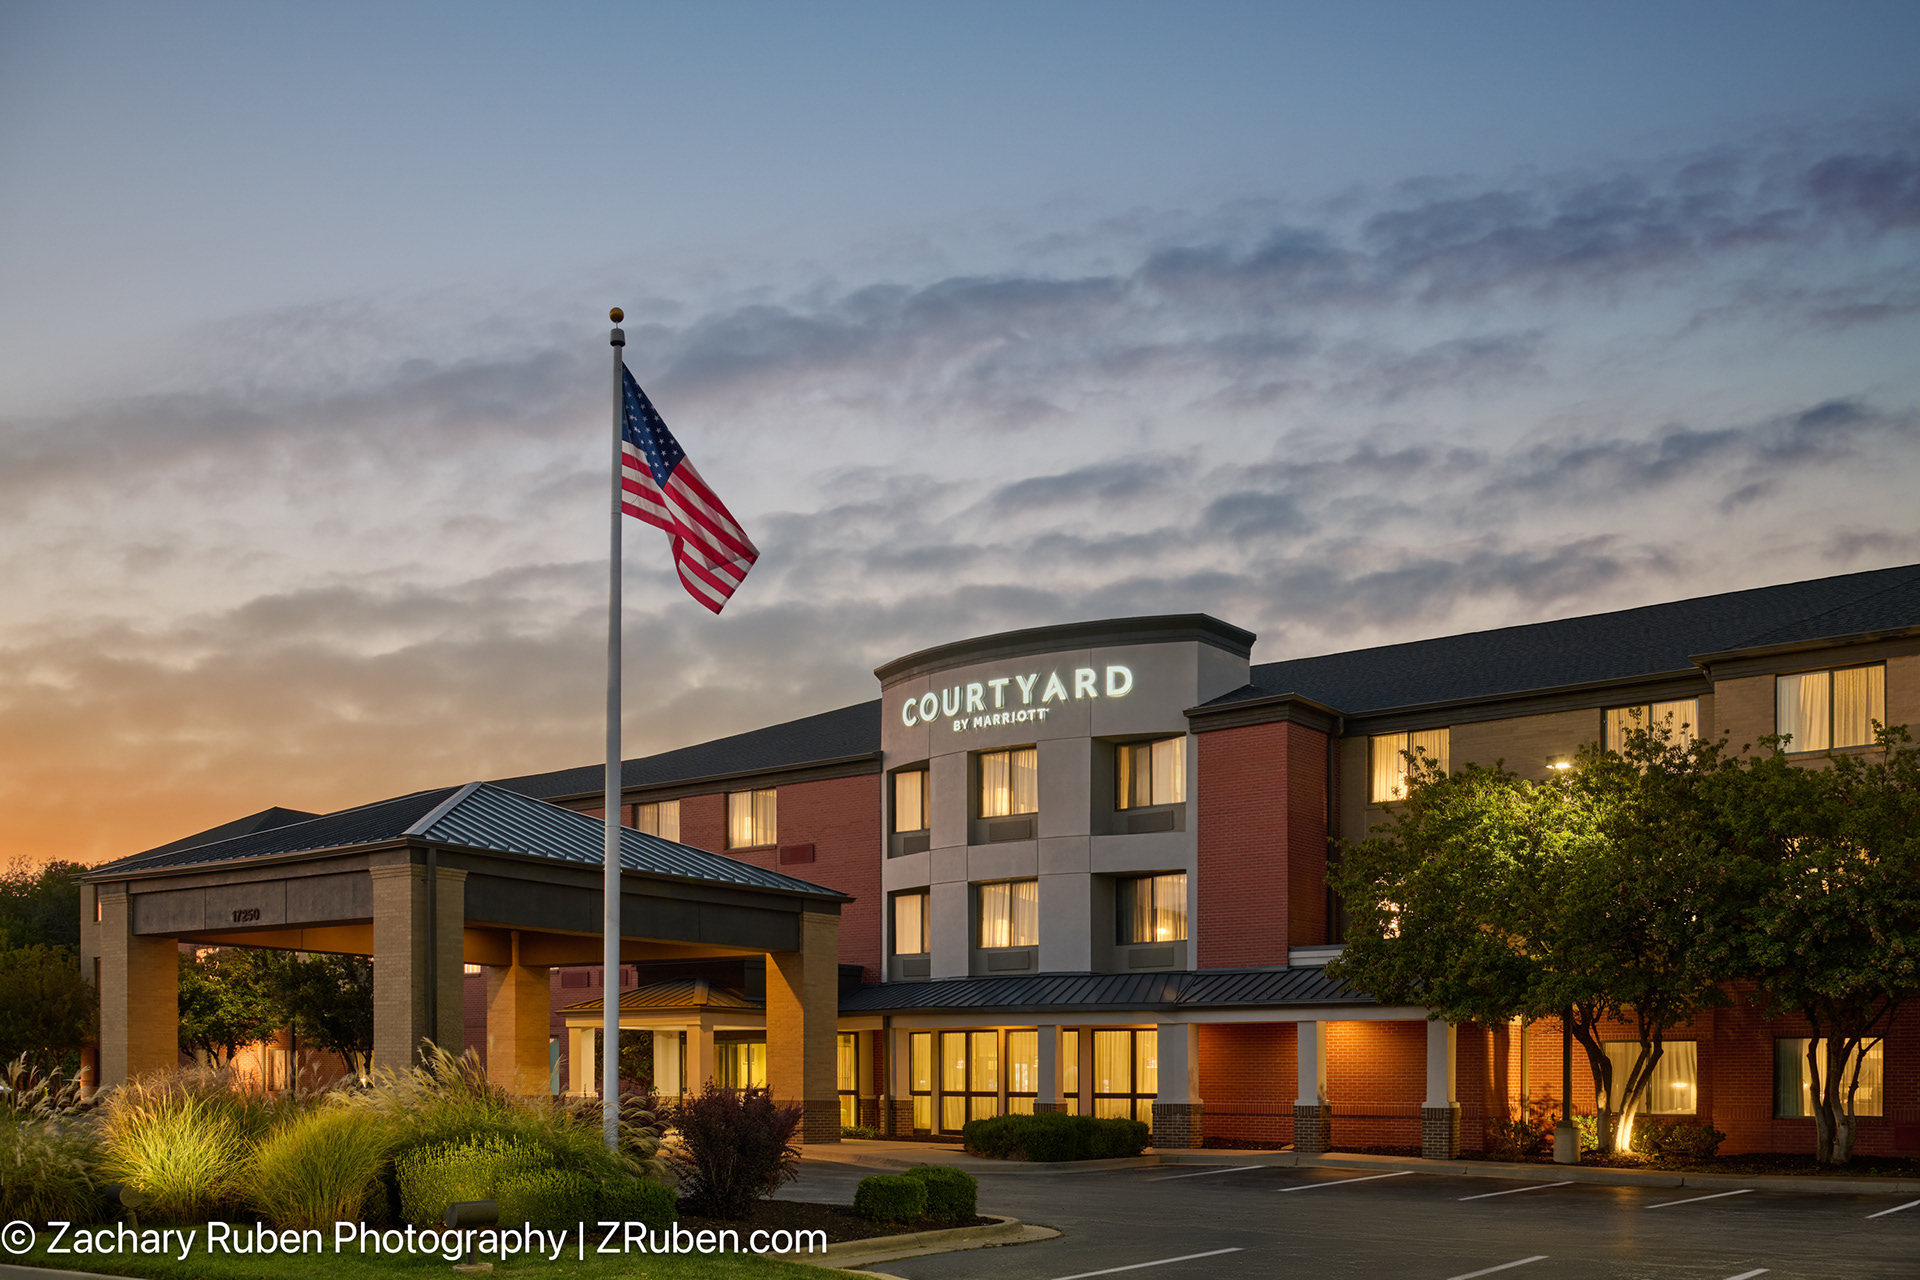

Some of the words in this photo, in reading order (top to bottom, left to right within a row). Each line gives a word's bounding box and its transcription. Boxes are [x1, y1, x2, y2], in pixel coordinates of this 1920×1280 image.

[902, 665, 1133, 727] COURTYARD
[953, 719, 969, 732] BY
[973, 708, 1046, 729] MARRIOTT
[232, 908, 260, 922] 17250
